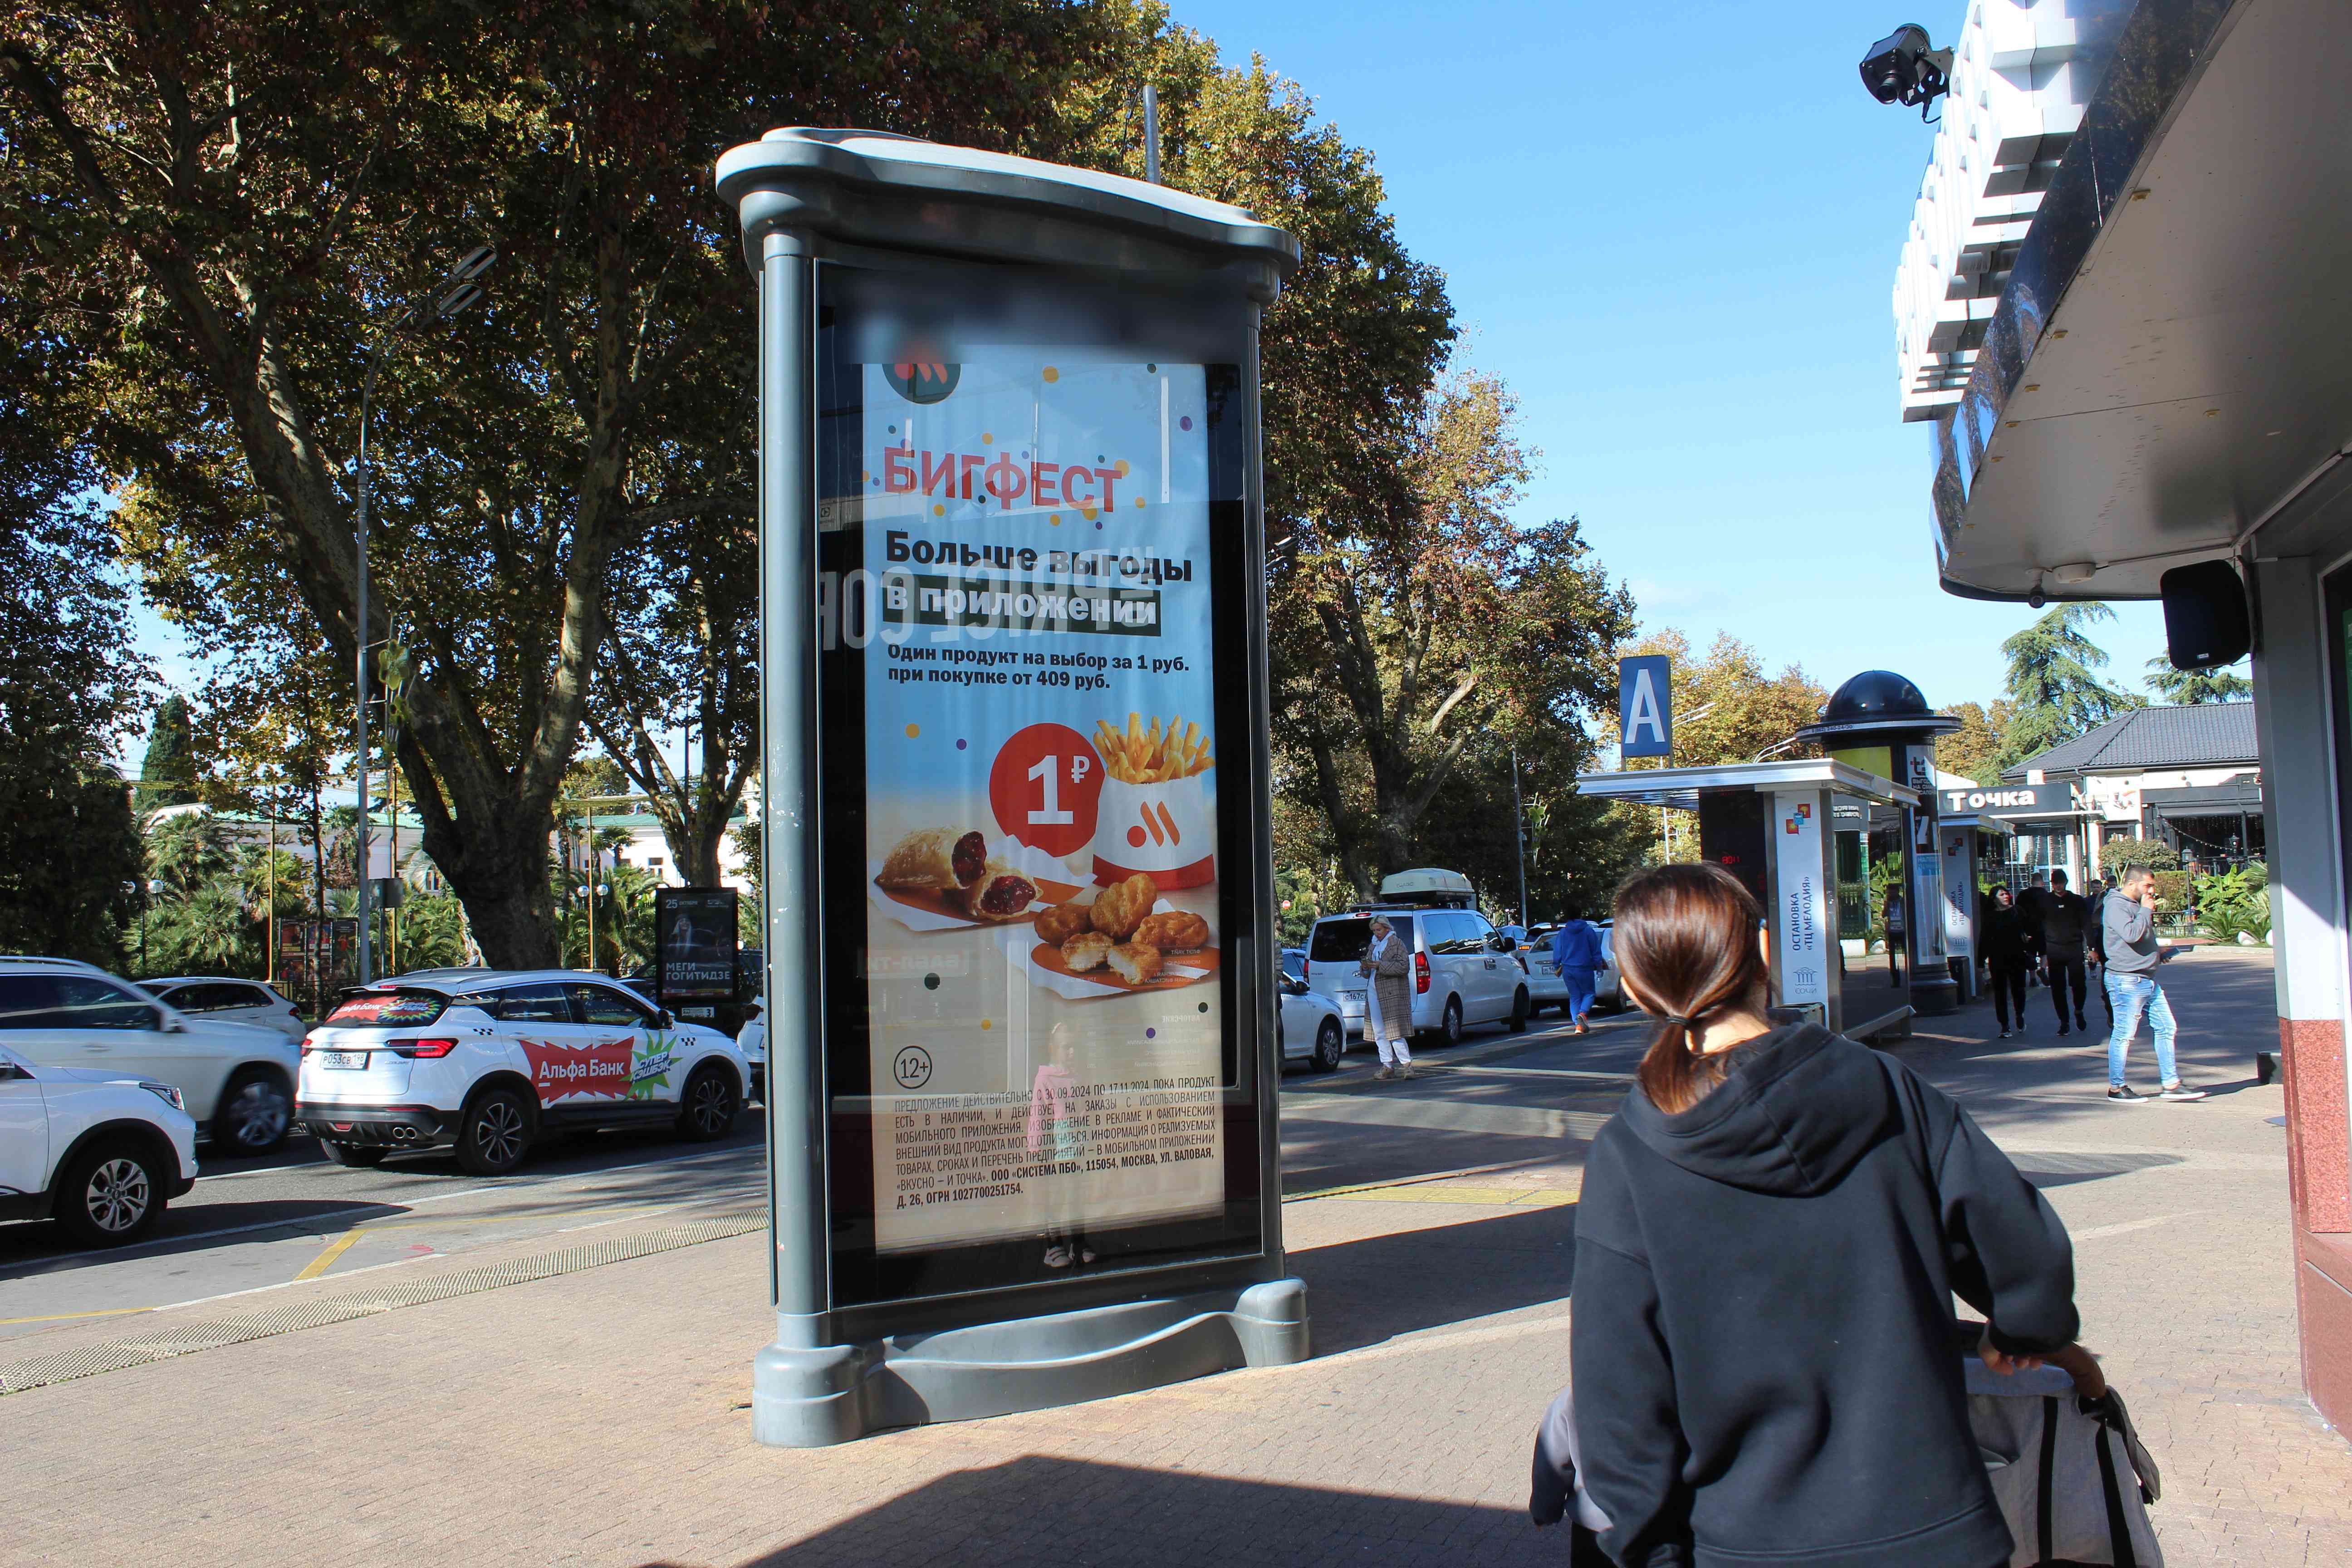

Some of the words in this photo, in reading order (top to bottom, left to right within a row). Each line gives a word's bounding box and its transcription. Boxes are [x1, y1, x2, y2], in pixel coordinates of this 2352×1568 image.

[884, 446, 1123, 513] БИГФЕСТ
[886, 530, 1039, 572] Больше
[1049, 549, 1192, 585] выгоды
[887, 585, 908, 610] в
[920, 587, 1156, 625] приложении
[887, 643, 937, 666] Один
[942, 648, 1019, 667] продукт
[1024, 652, 1044, 665] на
[1050, 652, 1107, 671] выбор
[1112, 656, 1133, 670] за
[1137, 655, 1148, 670] 1
[1152, 657, 1190, 674] руб.
[888, 666, 924, 682] при
[928, 669, 1008, 686] покупке
[1012, 672, 1032, 685] от
[1036, 671, 1070, 686] 409
[1075, 674, 1111, 690] руб.
[1624, 669, 1666, 744] А
[1947, 790, 2036, 812] Точка
[666, 899, 677, 909] 25
[1802, 877, 1813, 930] МЕЛОДИЯ»
[1791, 892, 1800, 951] ОСТАНОВКА
[1804, 932, 1814, 951] «ТЦ
[666, 962, 696, 971] МЕГИ
[666, 971, 730, 980] ГОГИТИДЗЕ
[539, 1059, 587, 1082] Альфа
[589, 1058, 624, 1077] Банк
[631, 1060, 671, 1083] КЭШБЭК
[639, 1051, 668, 1069] СУПЕР
[901, 1057, 929, 1079] 12+
[895, 1096, 959, 1113] ПРЕДЛОЖЕНИЕ
[963, 1090, 1033, 1108] ДЕЙСТВИТЕЛЬНО
[1037, 1089, 1042, 1100] С
[1045, 1085, 1090, 1100] 30.09.2024
[1094, 1084, 1105, 1095] ПО
[1109, 1080, 1151, 1094] 17.11.2024,
[1154, 1078, 1174, 1089] ПОКА
[1178, 1076, 1215, 1089] ПРОДУКТ
[896, 1115, 914, 1128] ЕСТЬ
[925, 1114, 930, 1126] В
[941, 1110, 985, 1124] НАЛИЧИИ,
[996, 1108, 1001, 1119] И
[1011, 1103, 1056, 1121] ДЕЙСТВУЕТ
[1065, 1102, 1075, 1113] НА
[1085, 1098, 1117, 1112] ЗАКАЗЫ
[1126, 1097, 1131, 1107] С
[1140, 1091, 1215, 1107] ИСПОЛЬЗОВАНИЕМ
[896, 1127, 956, 1144] МОБИЛЬНОГО
[962, 1122, 1023, 1138] ПРИЛОЖЕНИЯ.
[1029, 1115, 1090, 1131] ИЗОБРАЖЕНИЕ
[1096, 1114, 1101, 1126] В
[1107, 1111, 1142, 1124] РЕКЛАМЕ
[1147, 1110, 1152, 1121] И
[1156, 1103, 1215, 1119] ФАКТИЧЕСКИЙ
[897, 1143, 940, 1160] ВНЕШНИЙ
[944, 1142, 961, 1156] ВИД
[964, 1138, 1005, 1154] ПРОДУКТА
[1008, 1136, 1034, 1148] МОГУТ
[1037, 1131, 1089, 1146] ОТЛИЧАТЬСЯ.
[1092, 1124, 1148, 1141] ИНФОРМАЦИЯ
[1151, 1124, 1156, 1135] О
[1158, 1119, 1215, 1134] РЕАЛИЗУЕМЫХ
[896, 1161, 934, 1176] ТОВАРАХ,
[937, 1157, 969, 1171] СРОКАХ
[972, 1156, 978, 1168] И
[981, 1152, 1023, 1166] ПЕРЕЧЕНЬ
[1026, 1143, 1085, 1163] ПРЕДПРИЯТИЙ
[1097, 1144, 1102, 1156] В
[1105, 1138, 1156, 1155] МОБИЛЬНОМ
[1160, 1134, 1215, 1148] ПРИЛОЖЕНИИ
[897, 1176, 934, 1191] «ВКУСНО
[947, 1174, 953, 1186] И
[957, 1171, 988, 1185] ТОЧКА».
[991, 1168, 1009, 1181] ООО
[1012, 1164, 1057, 1179] «СИСТЕМА
[1059, 1161, 1083, 1174] ПБО»,
[1086, 1157, 1118, 1171] 115054,
[1122, 1153, 1157, 1167] МОСКВА,
[1161, 1152, 1172, 1163] УЛ.
[1175, 1147, 1214, 1161] ВАЛОВАЯ,
[897, 1195, 906, 1210] Д.
[910, 1193, 923, 1207] 26,
[926, 1190, 949, 1204] ОГРН
[953, 1182, 1024, 1201] 1027700251754.
